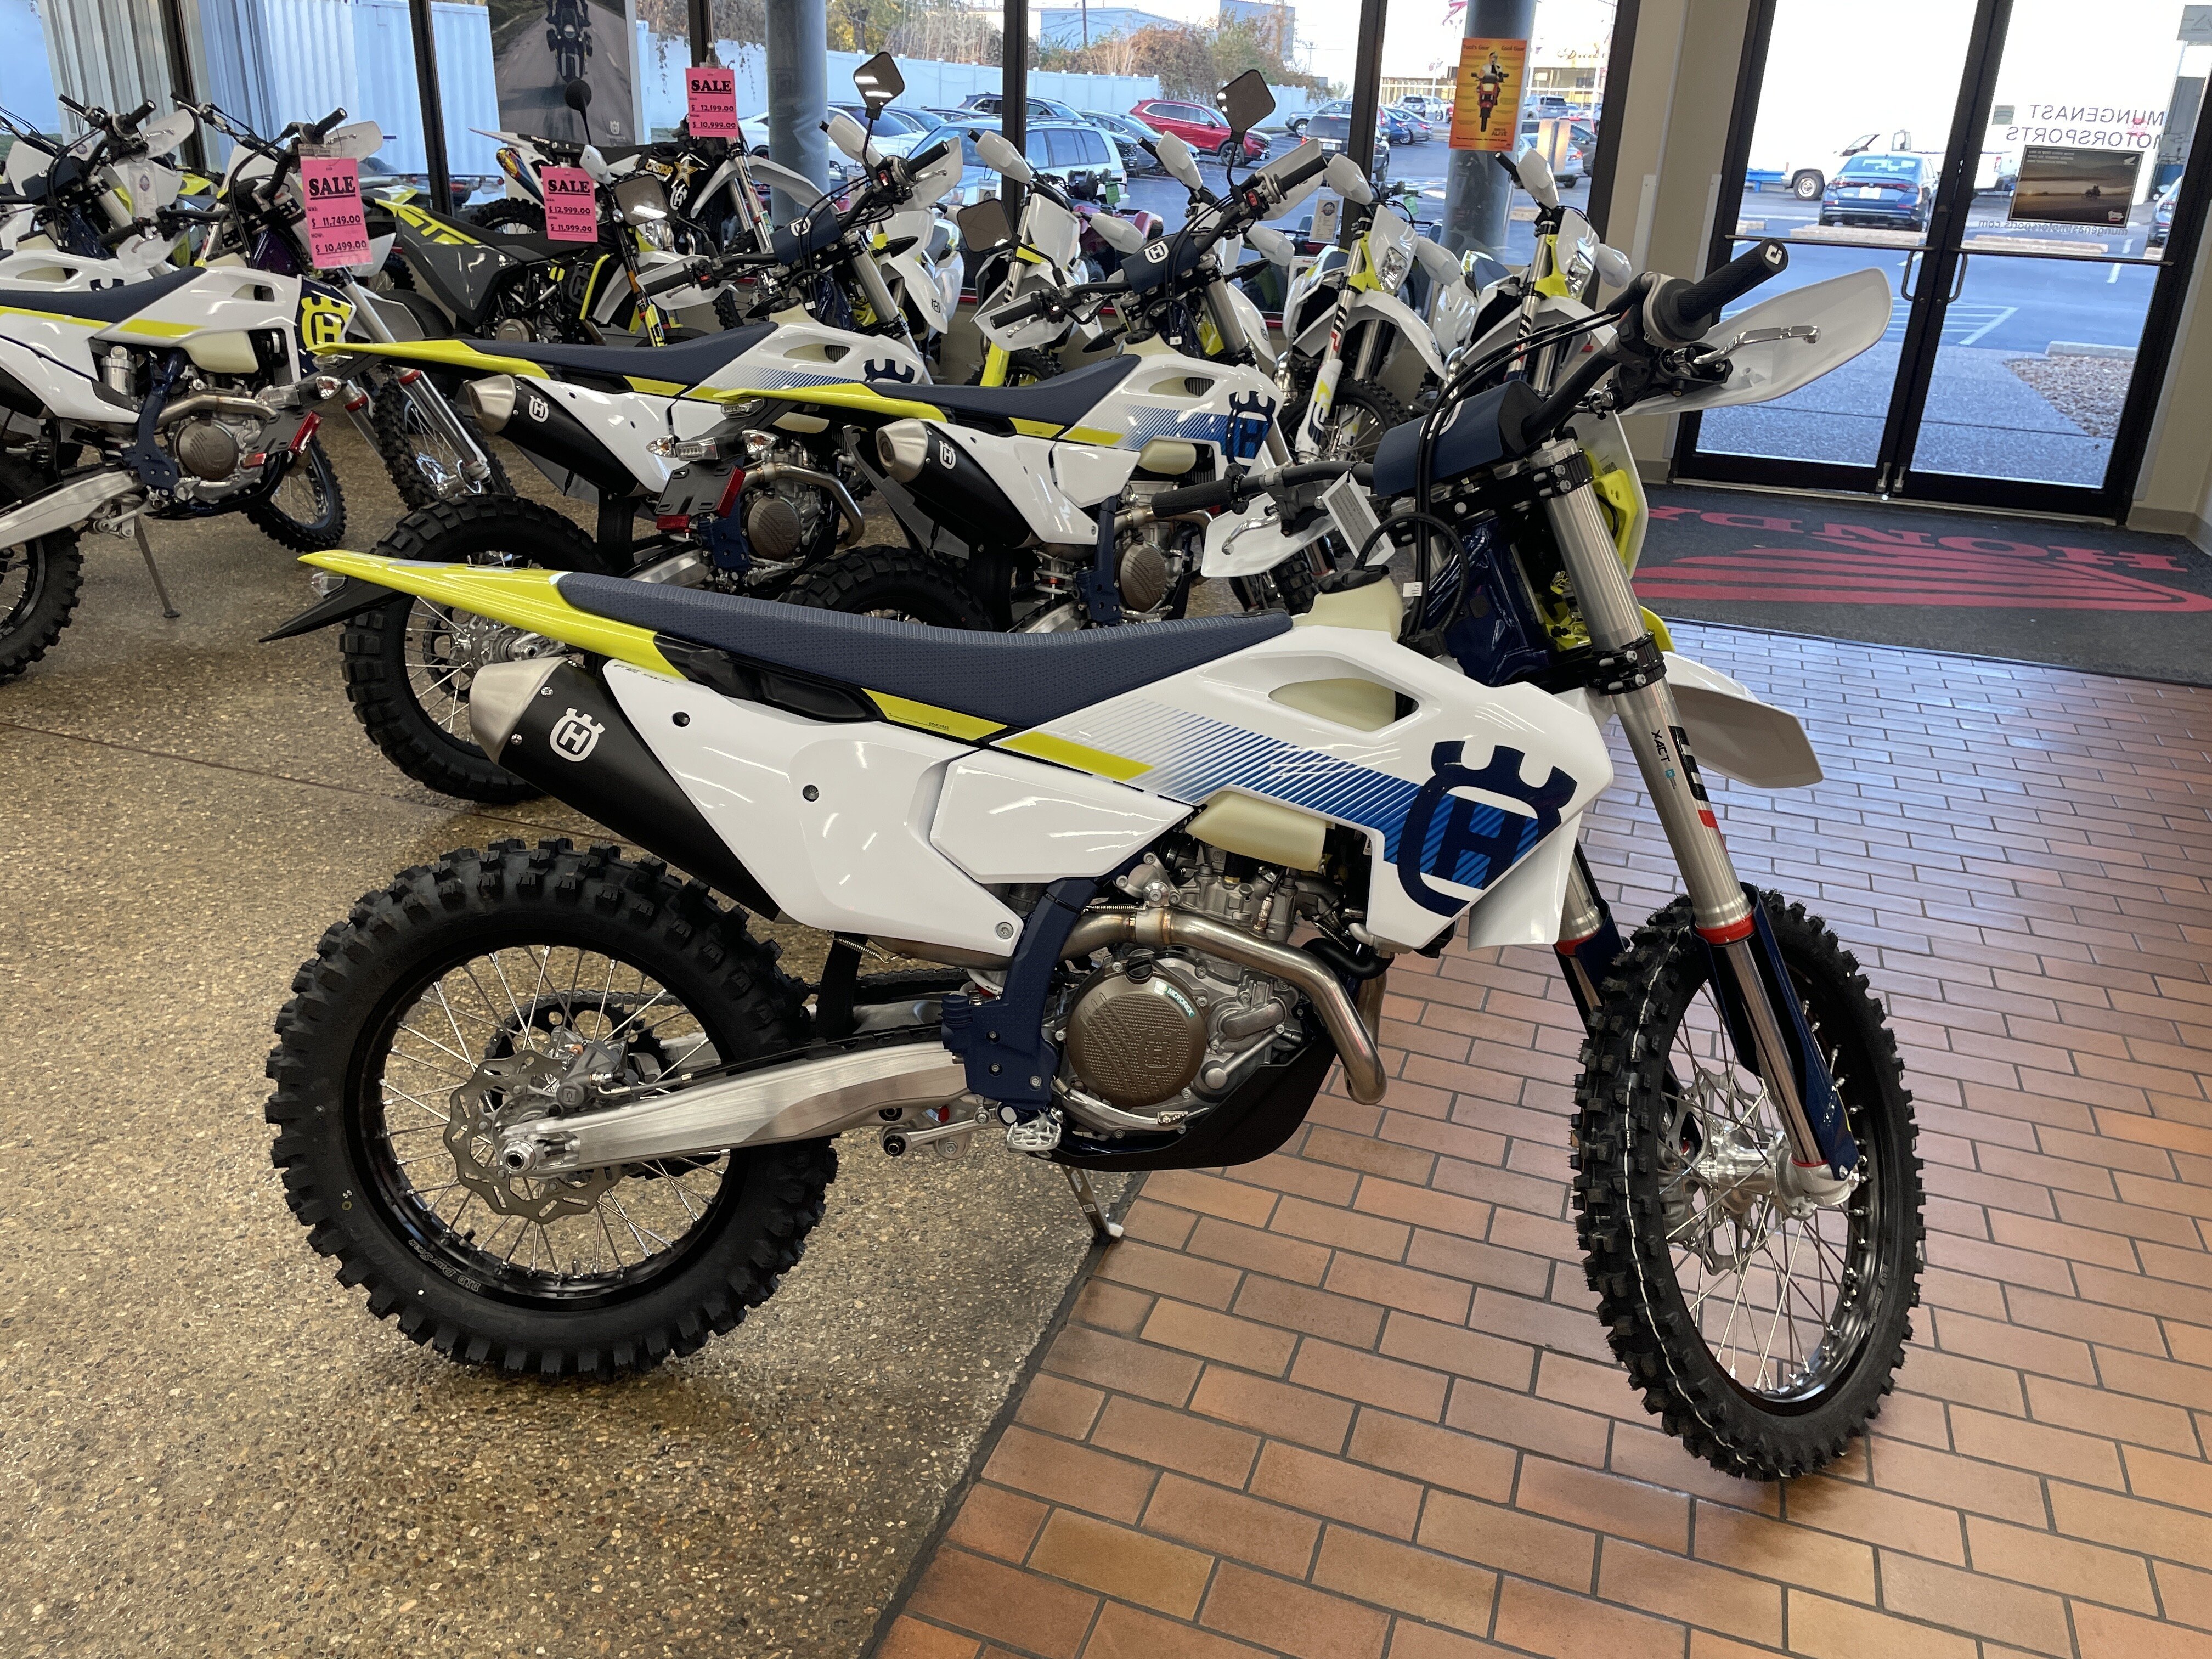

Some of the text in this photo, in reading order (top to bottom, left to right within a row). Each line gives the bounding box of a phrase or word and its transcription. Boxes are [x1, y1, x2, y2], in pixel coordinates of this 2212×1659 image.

[691, 80, 732, 92] SALE
[309, 176, 356, 196] SALE
[548, 179, 590, 193] SALE
[323, 215, 360, 227] 11,749.00
[324, 240, 367, 253] 10,499.00
[1651, 729, 1671, 761] XACT
[1167, 988, 1195, 1016] MOTOREX
